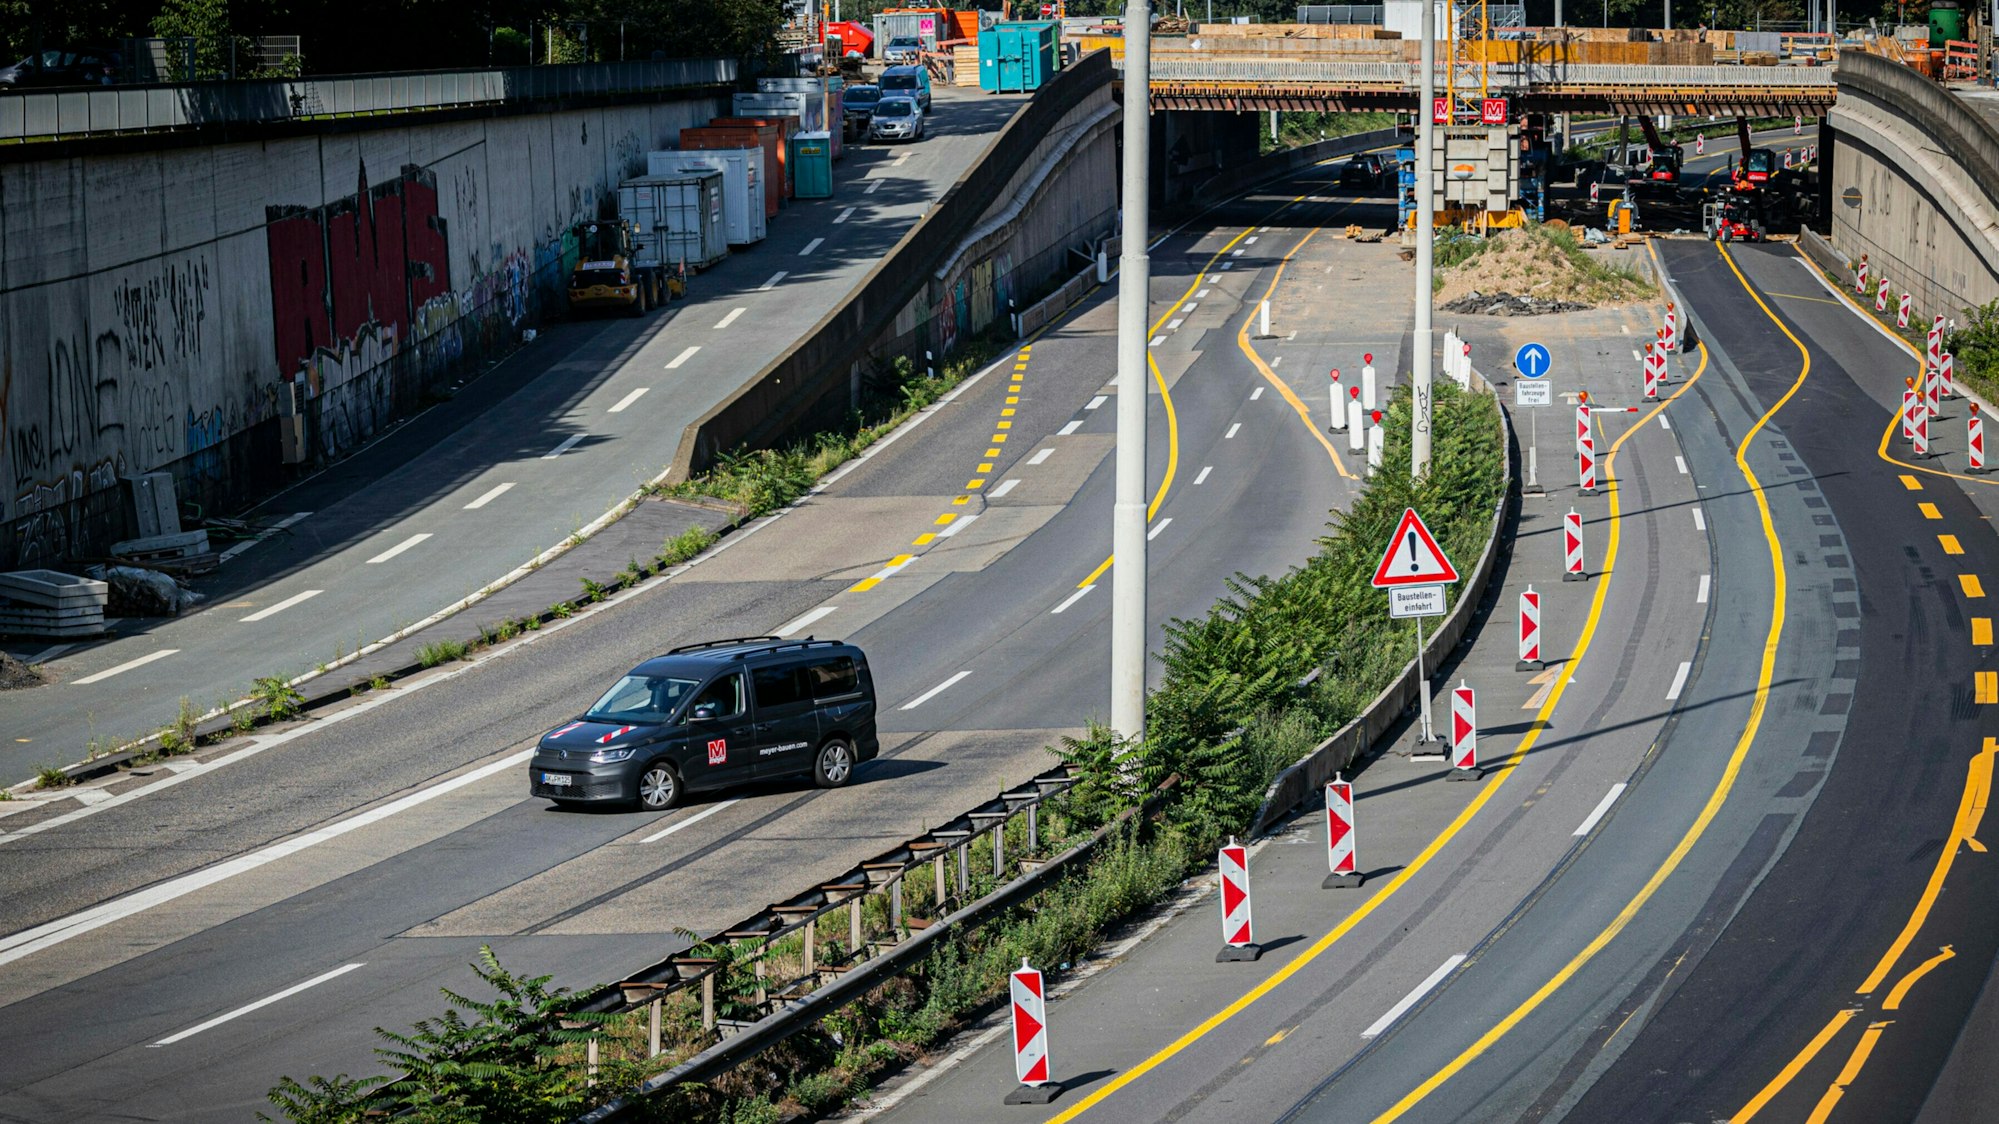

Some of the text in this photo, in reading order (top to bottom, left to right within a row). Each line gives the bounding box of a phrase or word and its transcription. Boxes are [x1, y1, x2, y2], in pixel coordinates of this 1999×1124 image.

[1397, 591, 1437, 601] Baustellen-
[1404, 602, 1433, 612] einfahrt
[759, 741, 808, 756] meyer-bauen.com
[708, 756, 726, 765] meyer
